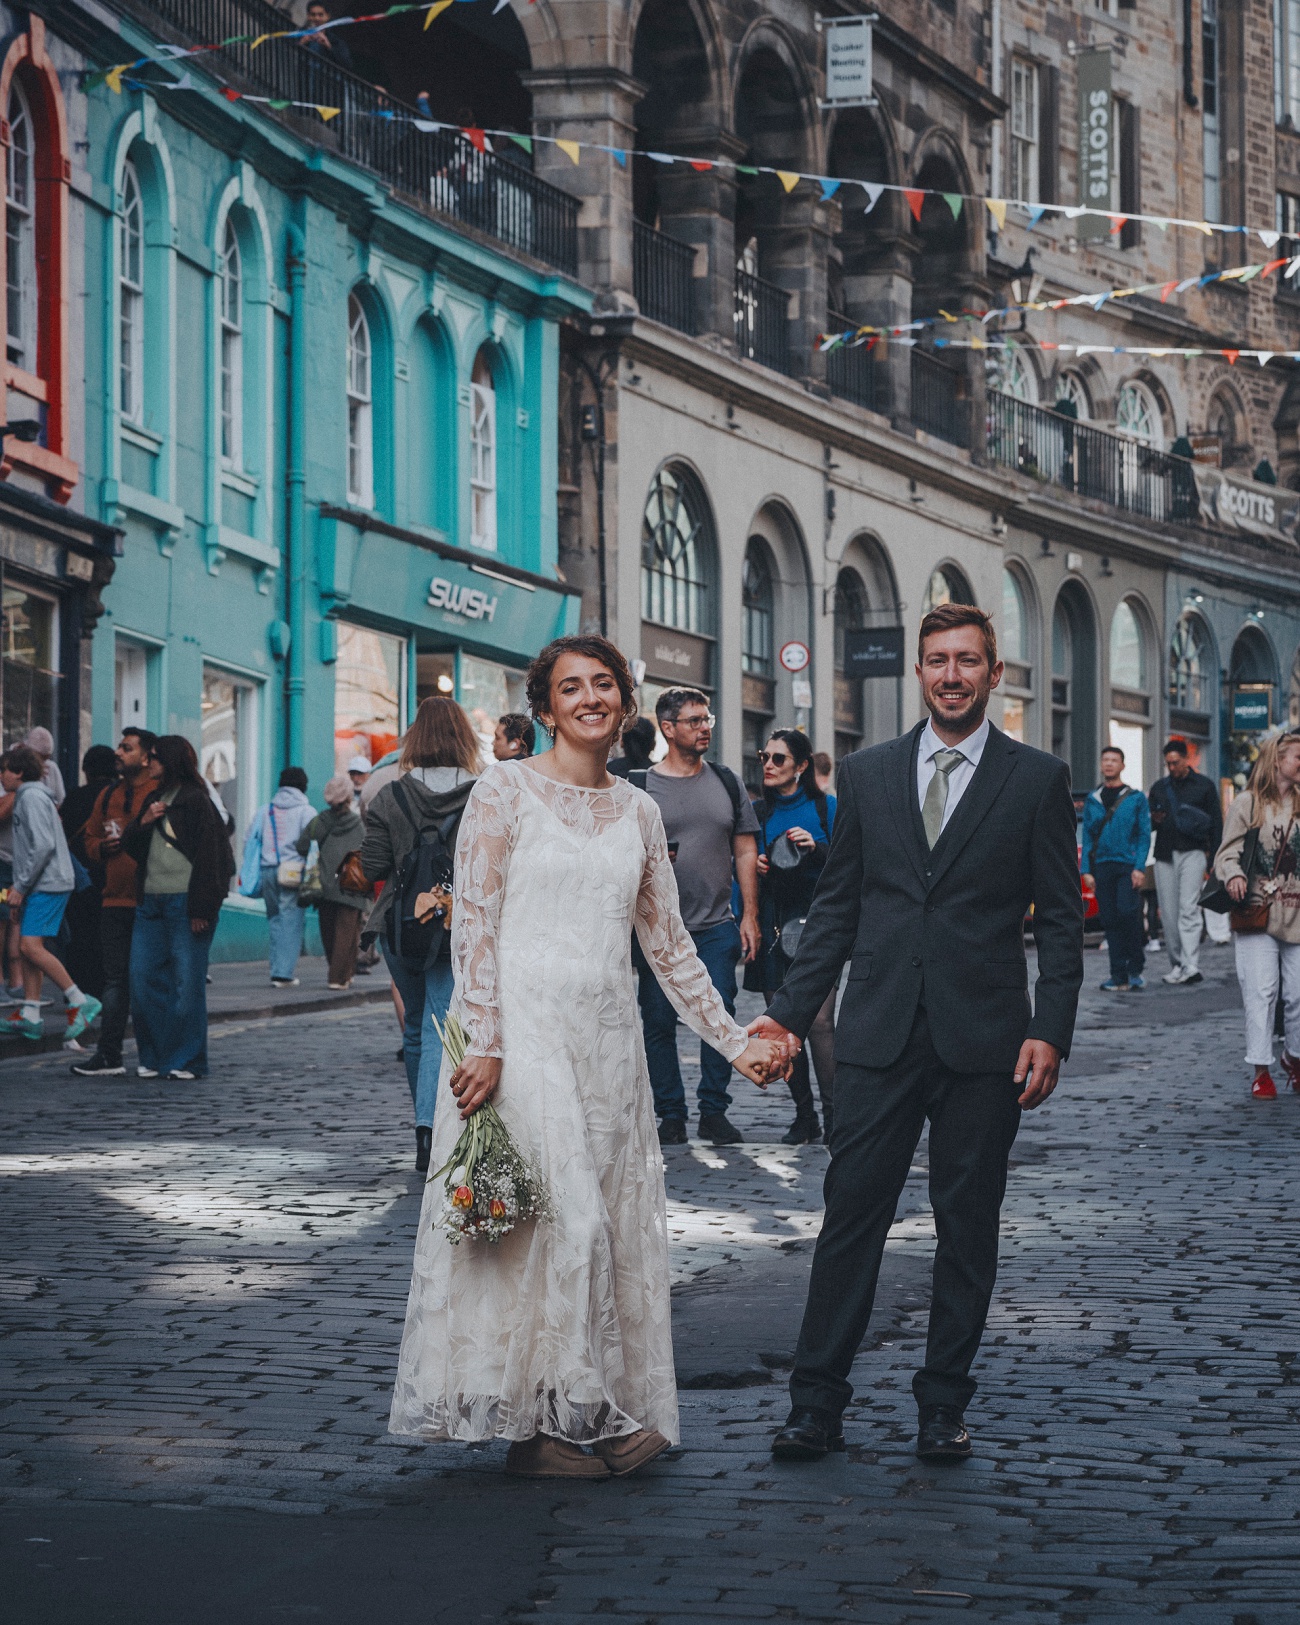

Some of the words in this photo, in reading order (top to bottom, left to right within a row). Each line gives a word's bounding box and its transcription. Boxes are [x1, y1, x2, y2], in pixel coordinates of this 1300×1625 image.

[831, 44, 863, 52] Quaker
[831, 59, 865, 67] Meeting
[1089, 90, 1108, 199] SCOTTS
[1219, 482, 1275, 524] SCOTTS
[427, 577, 498, 622] SWISH
